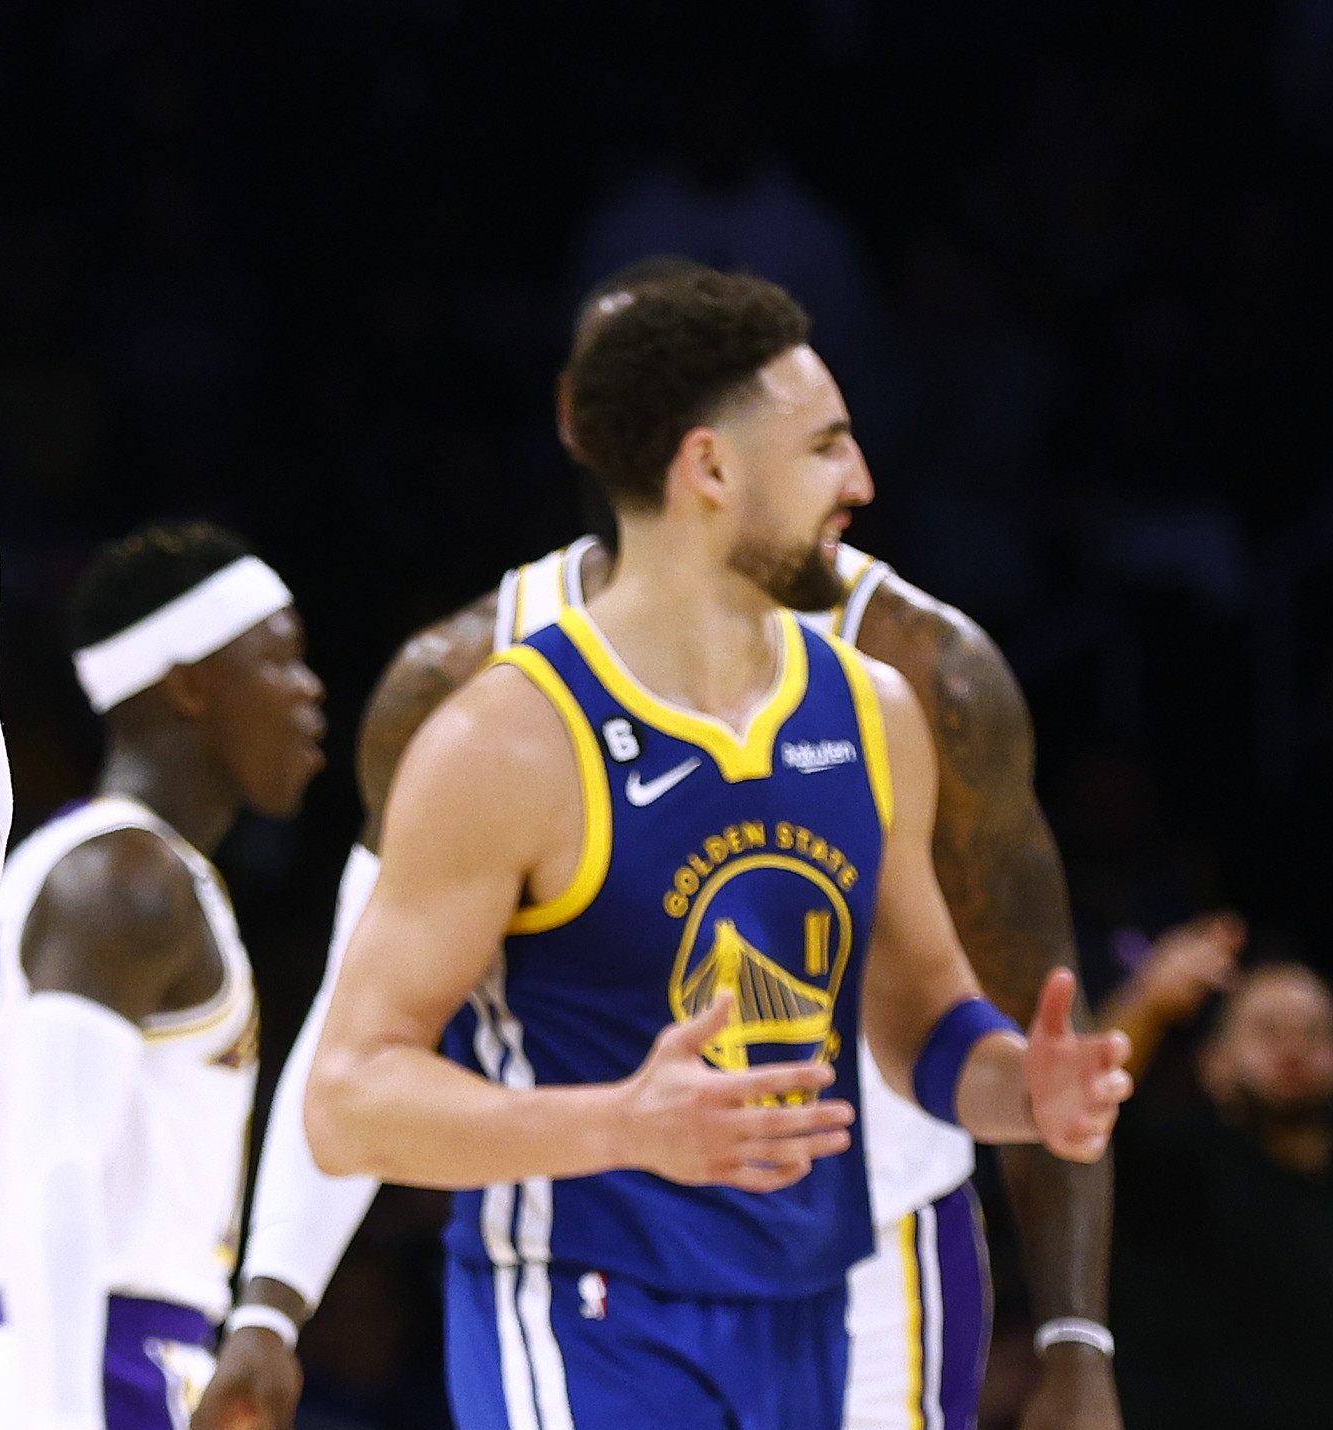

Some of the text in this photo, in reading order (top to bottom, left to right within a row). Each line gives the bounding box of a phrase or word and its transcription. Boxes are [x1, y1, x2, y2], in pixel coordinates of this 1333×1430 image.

[602, 717, 641, 763] 6
[663, 820, 859, 918] GOLDEN STATE
